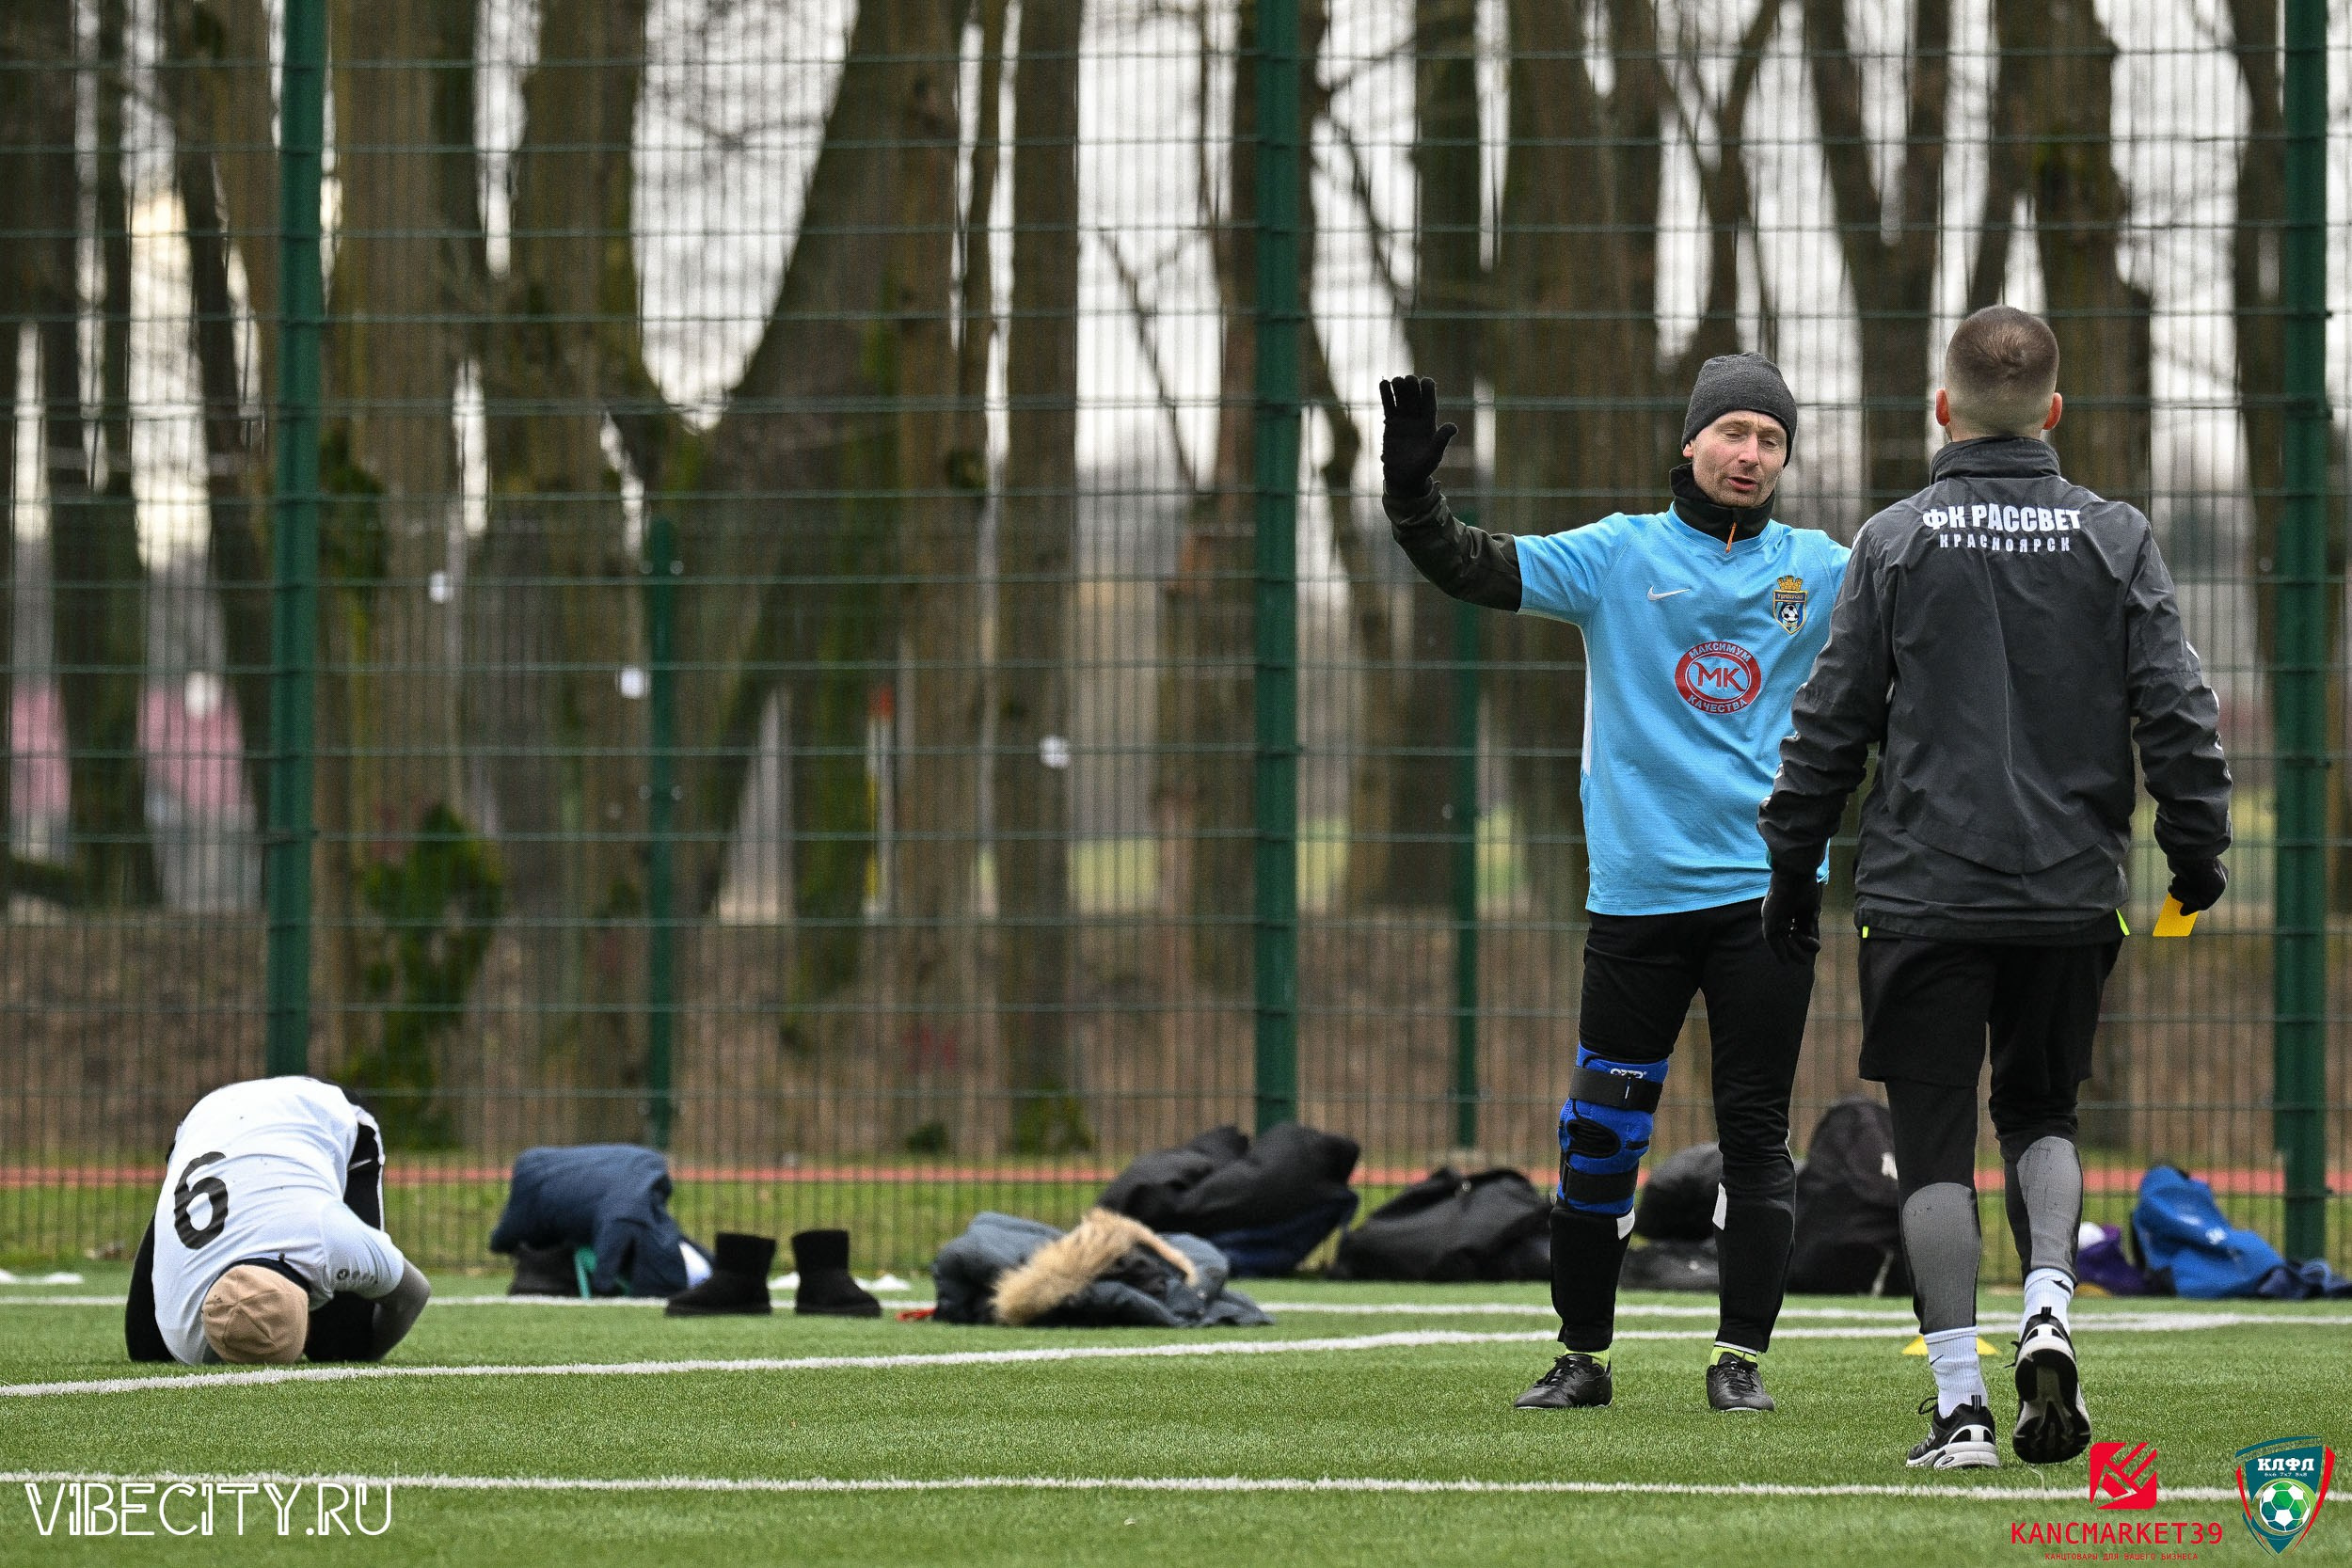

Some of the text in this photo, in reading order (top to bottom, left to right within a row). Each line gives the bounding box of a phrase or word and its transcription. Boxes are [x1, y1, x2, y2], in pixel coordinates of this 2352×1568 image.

[1923, 503, 2081, 532] ФК РАССВЕТ
[1939, 533, 2071, 553] КРАСНОЯРСК
[1689, 641, 1755, 662] МАКСИМУМ
[1693, 661, 1747, 692] МК
[1687, 694, 1748, 713] КАЧЕСТВА
